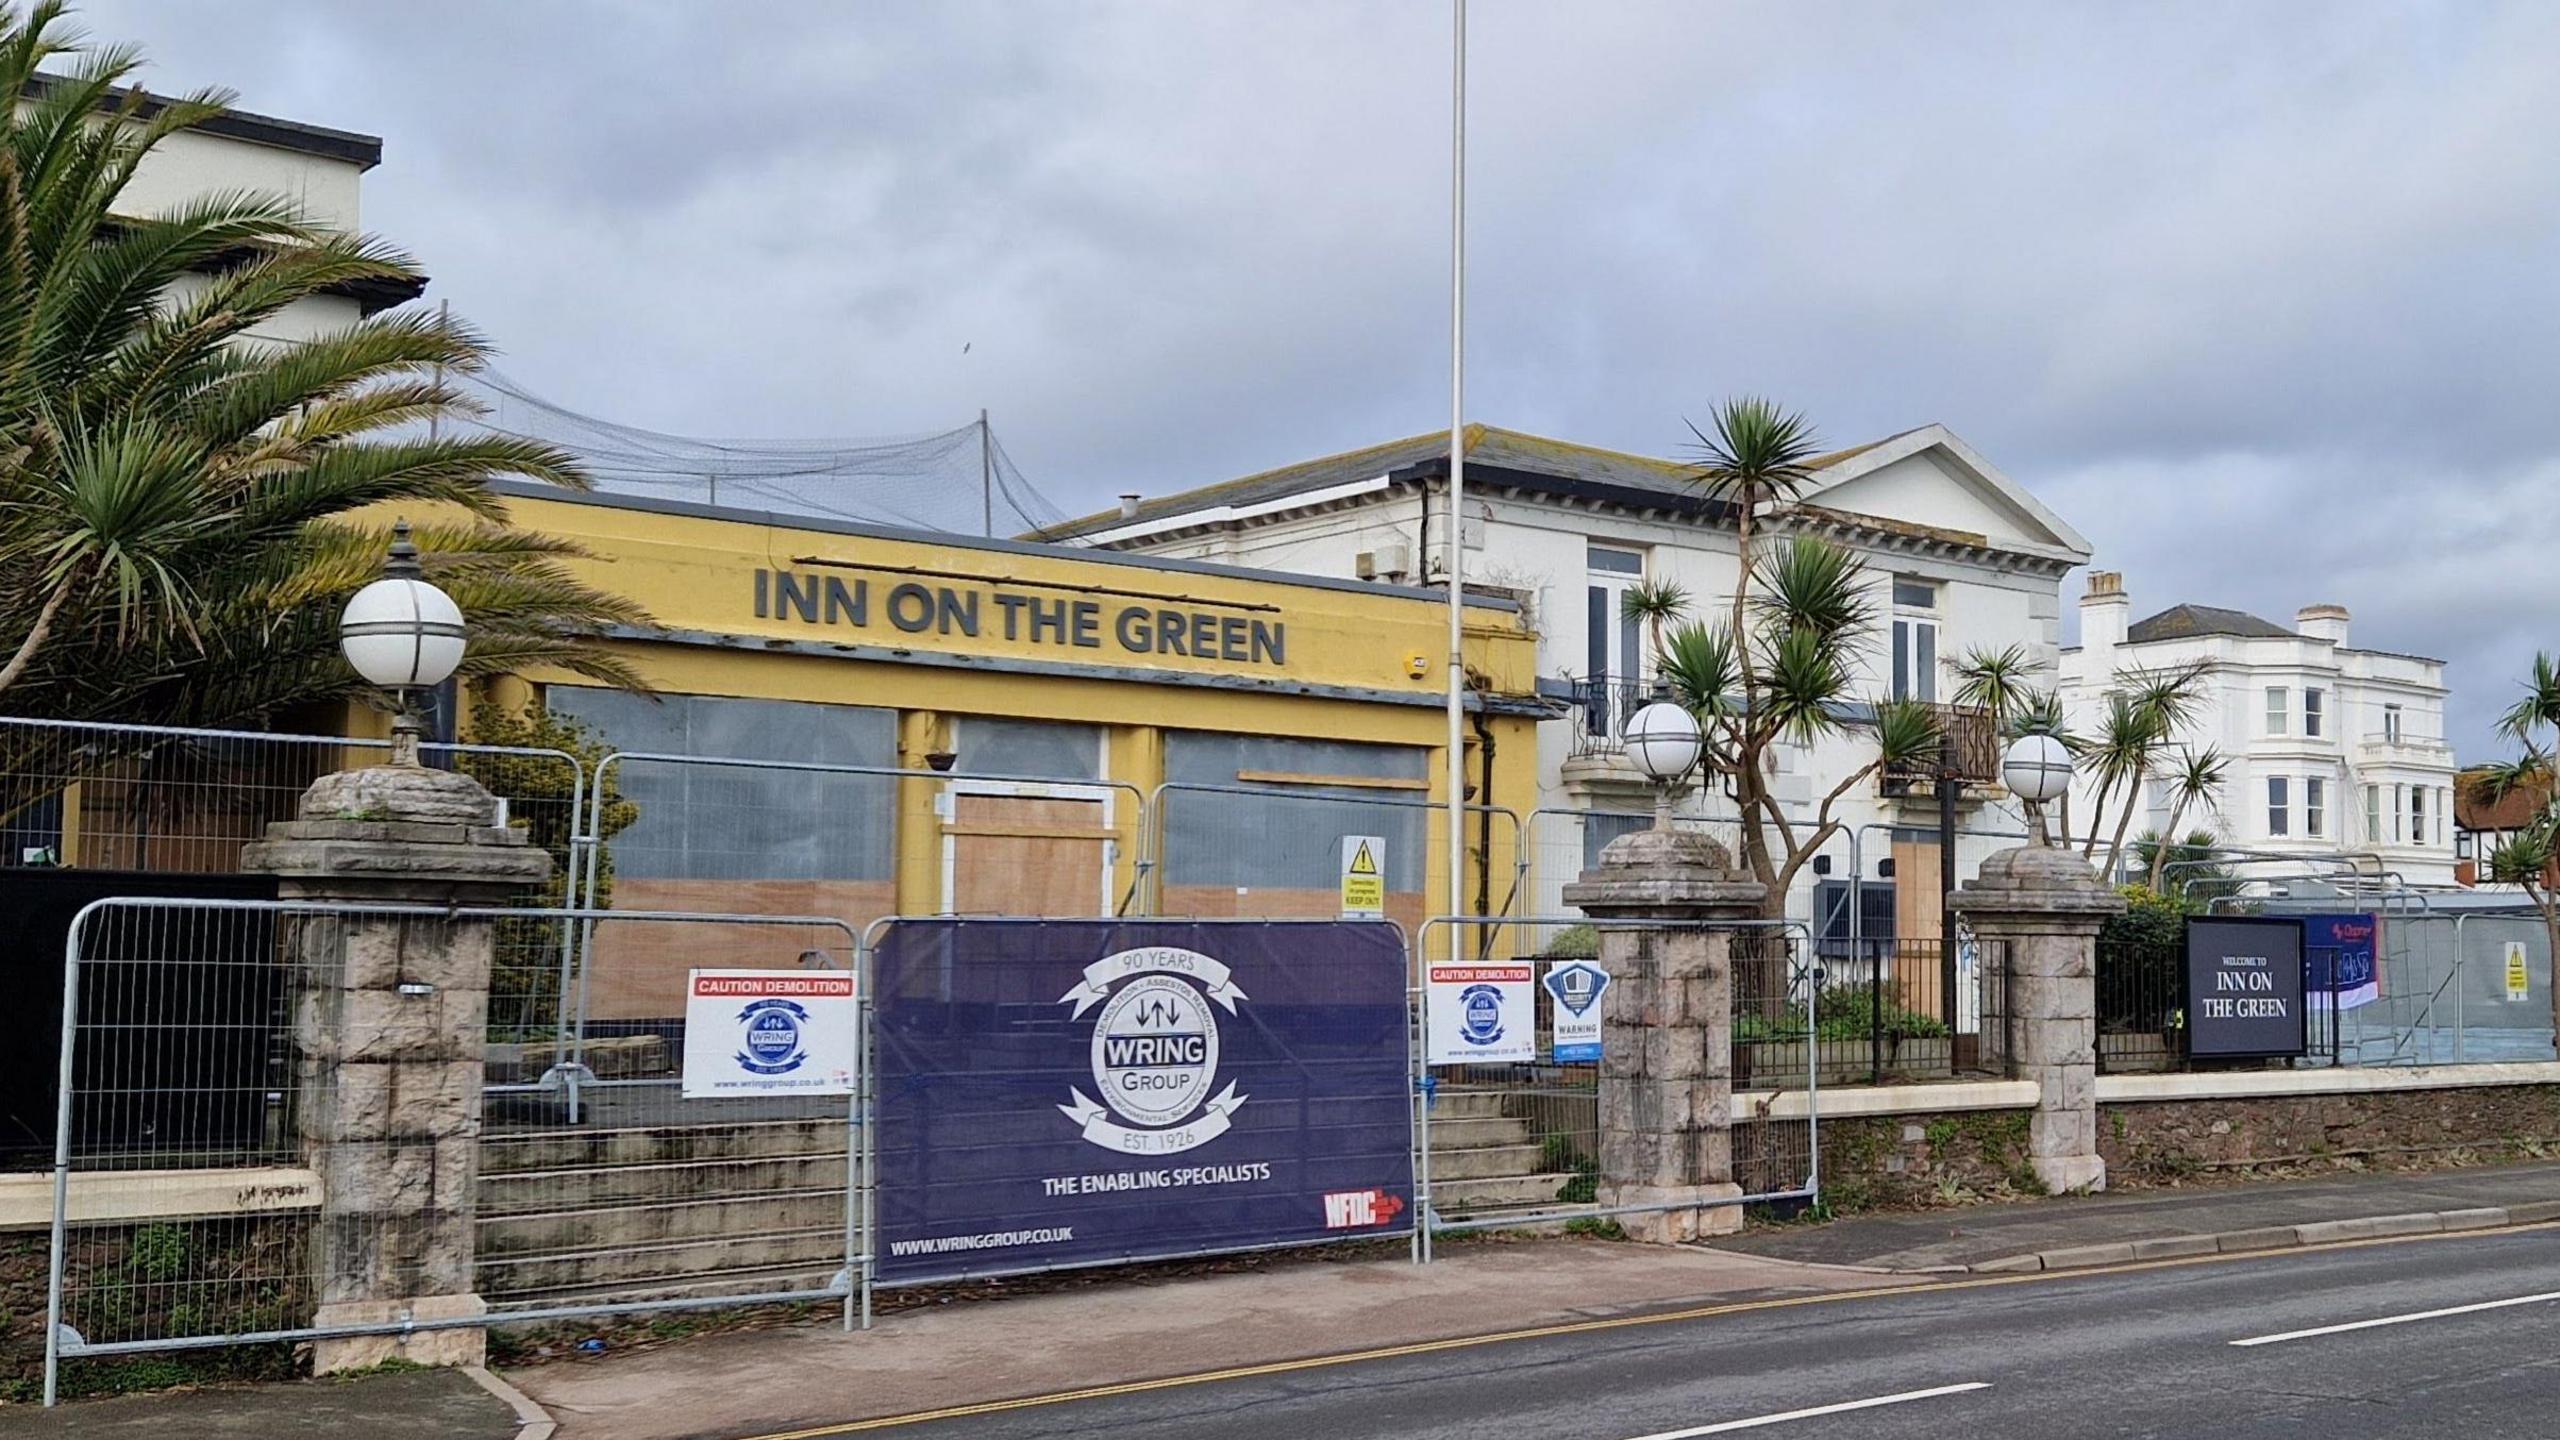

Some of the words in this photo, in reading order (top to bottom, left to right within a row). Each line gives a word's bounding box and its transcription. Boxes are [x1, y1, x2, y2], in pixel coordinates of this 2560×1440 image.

[754, 568, 867, 627] INN
[887, 583, 979, 638] ON
[994, 594, 1100, 648] THE
[1115, 606, 1285, 665] GREEN
[1123, 953, 1143, 970] 90
[1149, 951, 1195, 971] YEARS
[2222, 956, 2256, 966] WELCOME
[2257, 956, 2267, 966] TO
[1433, 969, 1474, 979] CAUTION
[1475, 969, 1529, 979] DEMOLITION
[2217, 972, 2246, 990] INN
[2250, 972, 2273, 990] ON
[699, 980, 762, 993] CAUTION
[765, 980, 849, 993] DEMOLITION
[2203, 999, 2234, 1018] THE
[2237, 999, 2287, 1018] GREEN
[752, 1032, 792, 1042] WRING
[1558, 1024, 1597, 1035] WARNING
[1106, 1037, 1204, 1066] WRING
[714, 1078, 825, 1089] www.wringgroup.co.uk
[1160, 1128, 1195, 1149] 1926
[1042, 1177, 1079, 1196] THE
[1081, 1170, 1171, 1194] ENABLING
[1173, 1163, 1271, 1186] SPECIALISTS
[1324, 1191, 1376, 1228] NFDC
[891, 1227, 1073, 1256] WWW.WRINGGROUP.CO.UK
